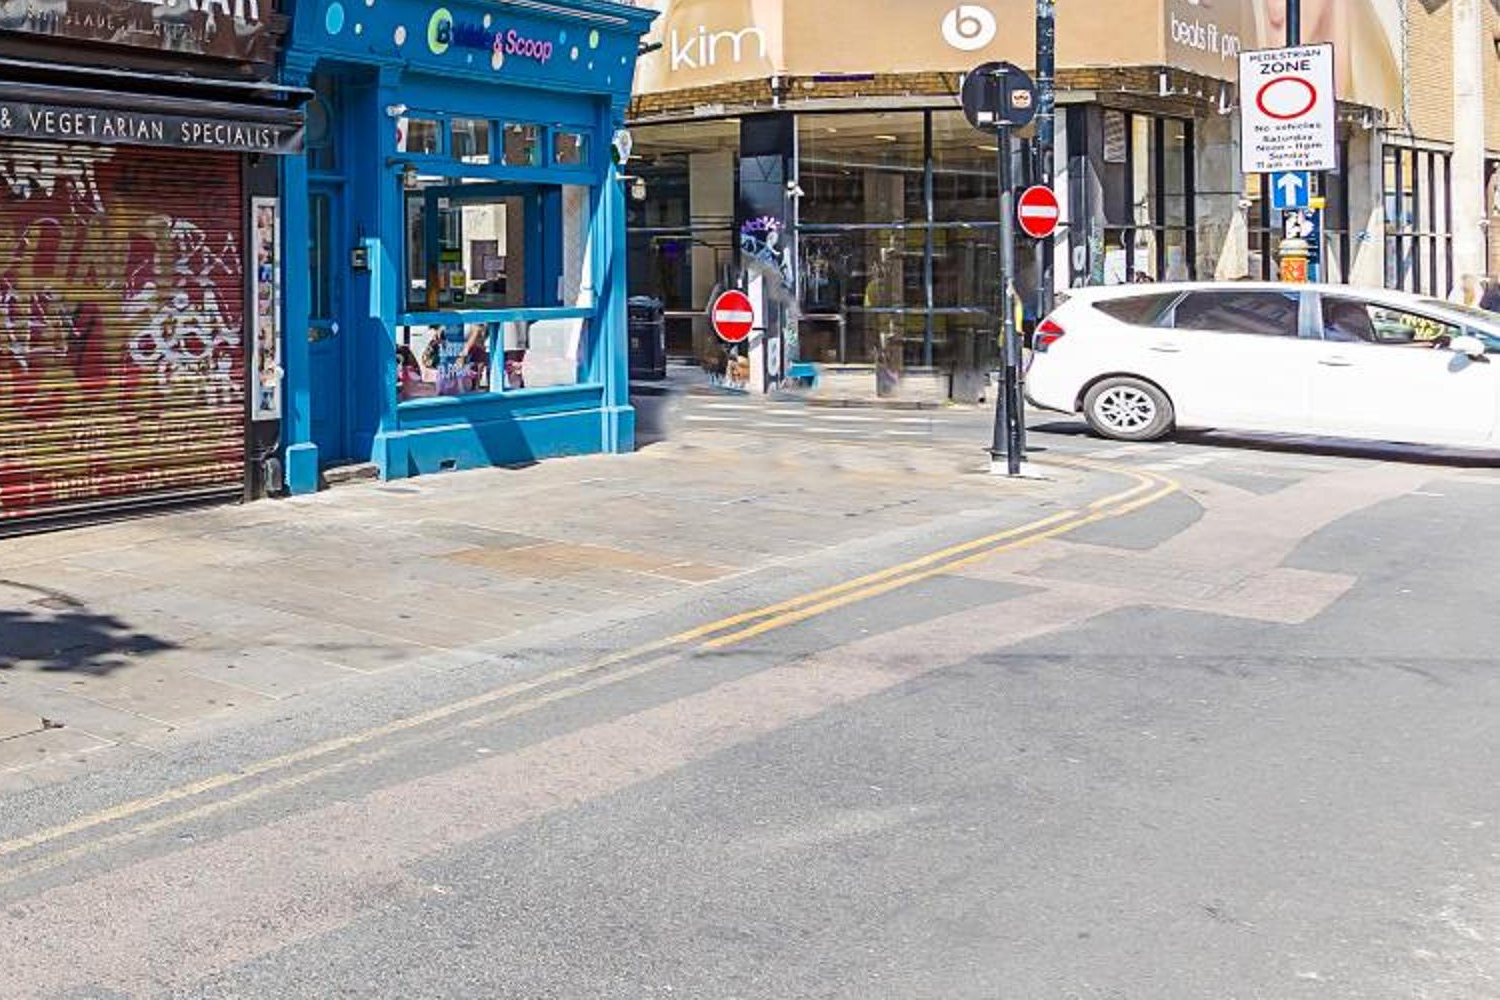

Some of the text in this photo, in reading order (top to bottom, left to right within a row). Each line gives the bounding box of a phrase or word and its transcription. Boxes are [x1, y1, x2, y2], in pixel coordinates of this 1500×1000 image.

[505, 29, 553, 65] Scoop
[670, 24, 766, 72] kim
[1249, 48, 1321, 63] PEDESTRIAN
[1260, 59, 1312, 75] ZONE
[0, 106, 13, 128] &
[29, 110, 163, 141] VEGETARIAN
[180, 122, 282, 149] SPECIALIST
[1263, 134, 1313, 144] Saturday
[1269, 152, 1310, 162] Sunday
